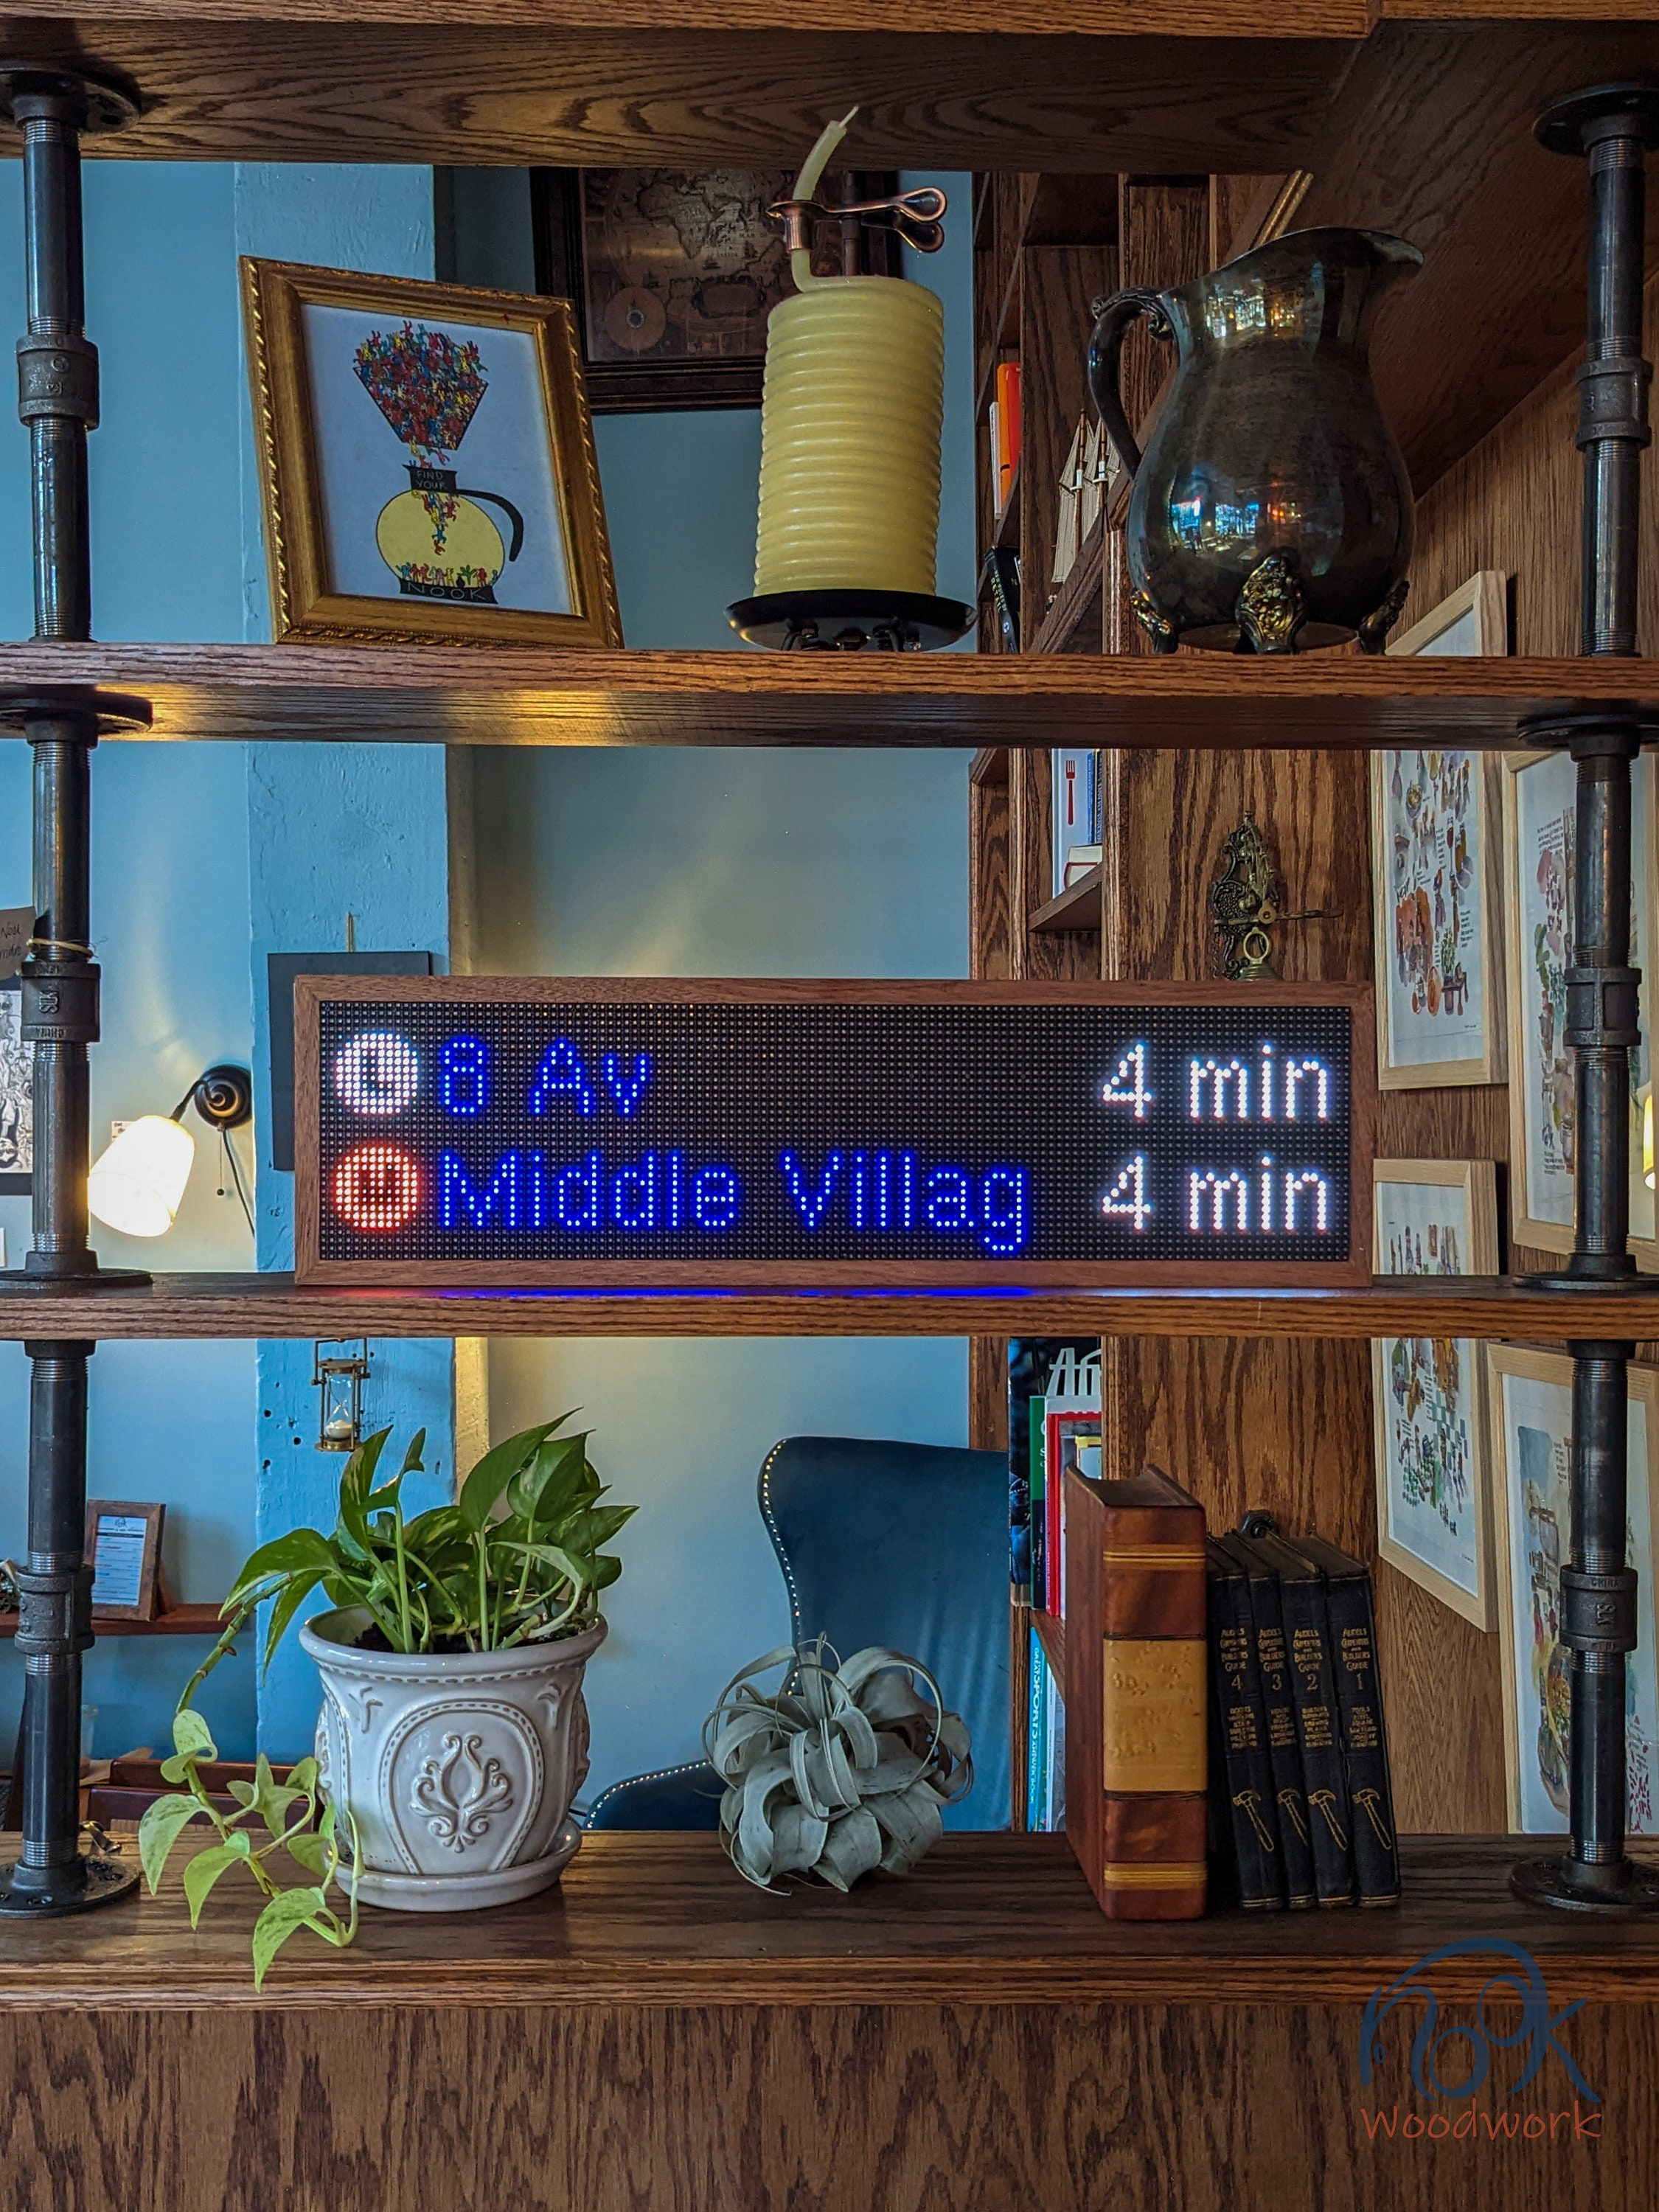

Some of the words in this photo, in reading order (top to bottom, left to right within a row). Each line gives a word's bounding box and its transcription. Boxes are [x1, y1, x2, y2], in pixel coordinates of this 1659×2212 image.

[417, 470, 443, 480] FIND
[416, 480, 447, 490] YOUR
[408, 581, 487, 602] NOOK
[444, 1040, 484, 1114] 8
[532, 1040, 647, 1115] Av
[1102, 1043, 1152, 1119] 4
[1189, 1043, 1327, 1119] min
[444, 1154, 735, 1228] Middle
[783, 1155, 1023, 1252] Villag
[1102, 1155, 1152, 1231] 4
[1189, 1155, 1327, 1231] min
[1346, 1661, 1368, 1672] GUIDE
[1231, 1674, 1242, 1690] 4
[1272, 1673, 1282, 1691] 3
[1307, 1673, 1318, 1691] 2
[1357, 1672, 1363, 1690] 1
[1032, 1674, 1040, 1739] SPORTS
